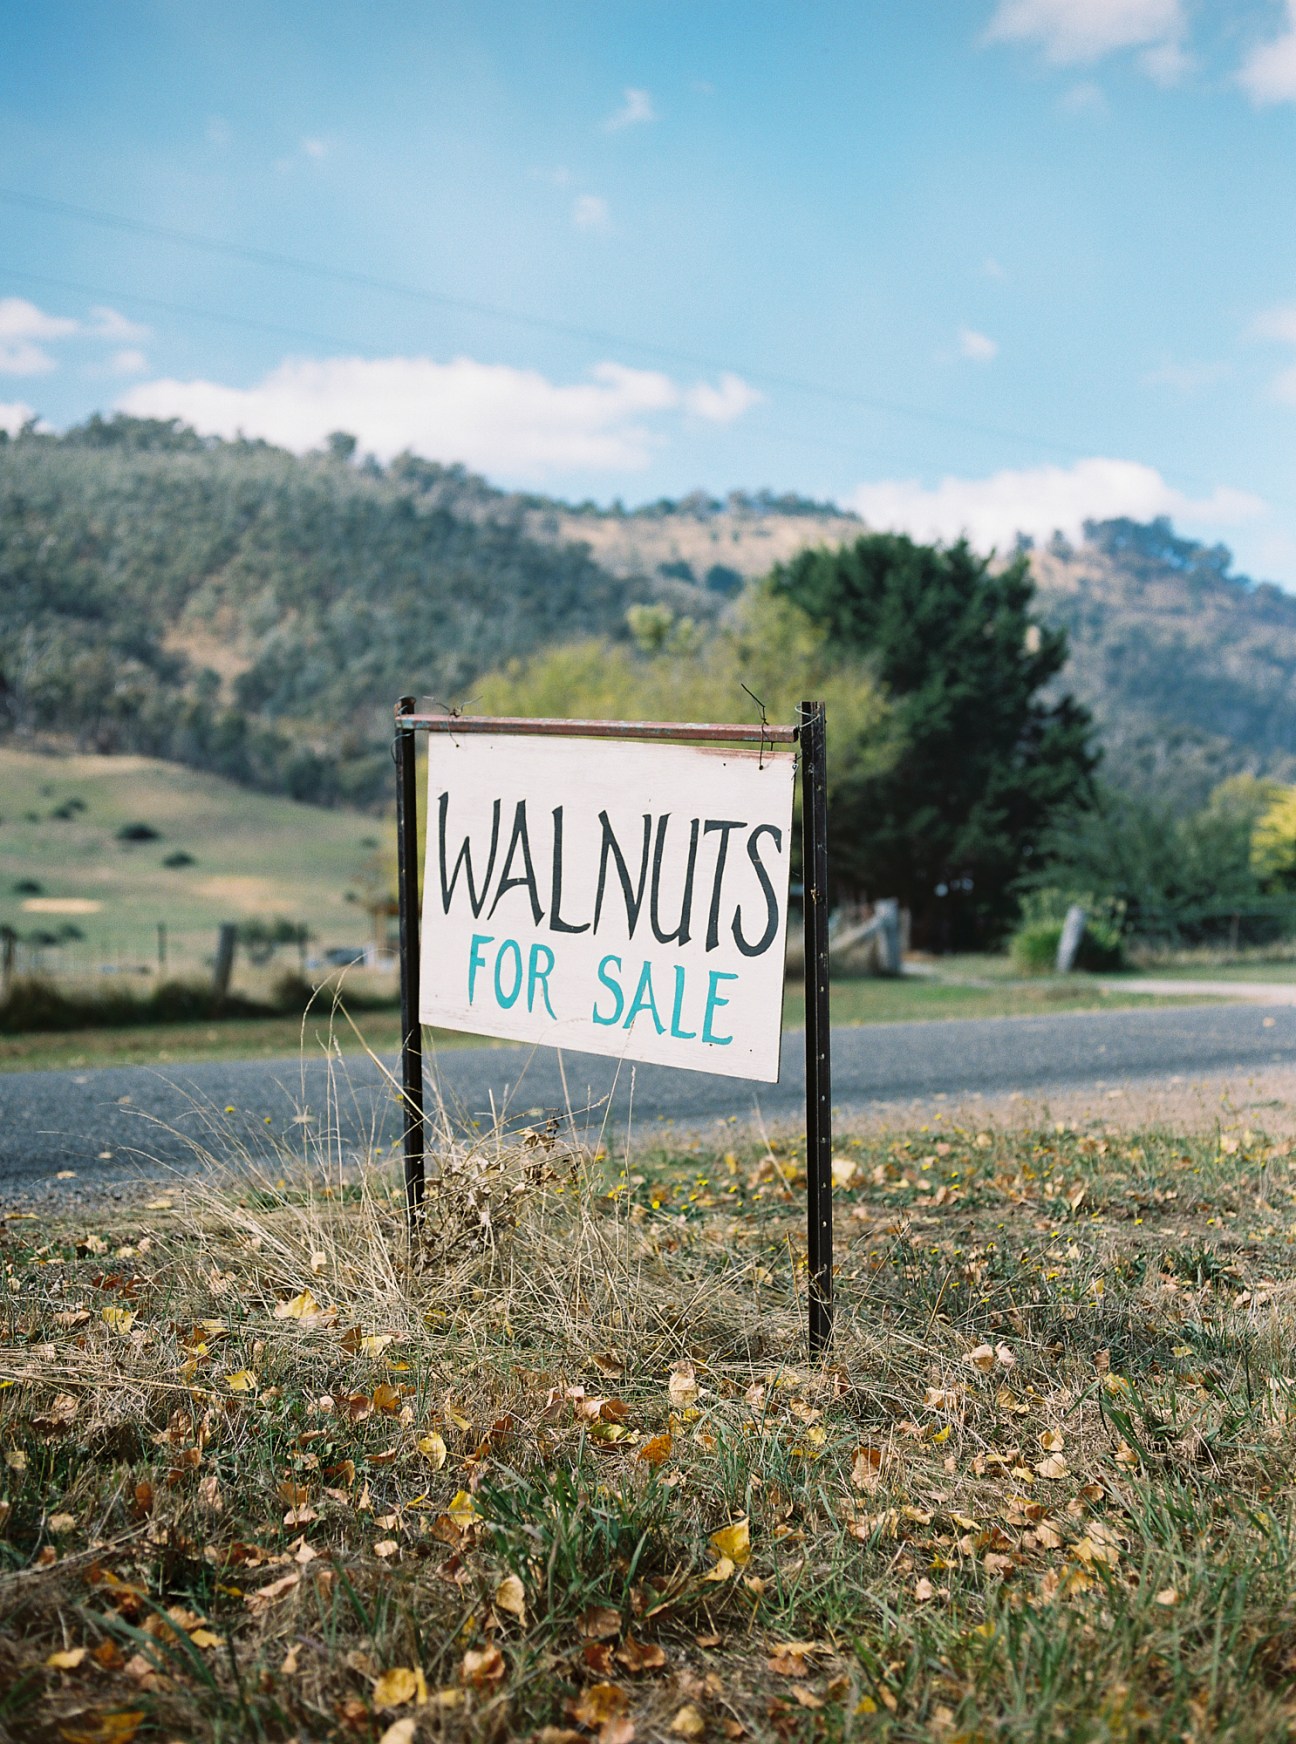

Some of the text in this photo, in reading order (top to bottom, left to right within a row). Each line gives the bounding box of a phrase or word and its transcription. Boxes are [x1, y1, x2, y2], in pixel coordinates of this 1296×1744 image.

[438, 791, 782, 958] WALNUTS
[468, 934, 739, 1046] FOR SALE
